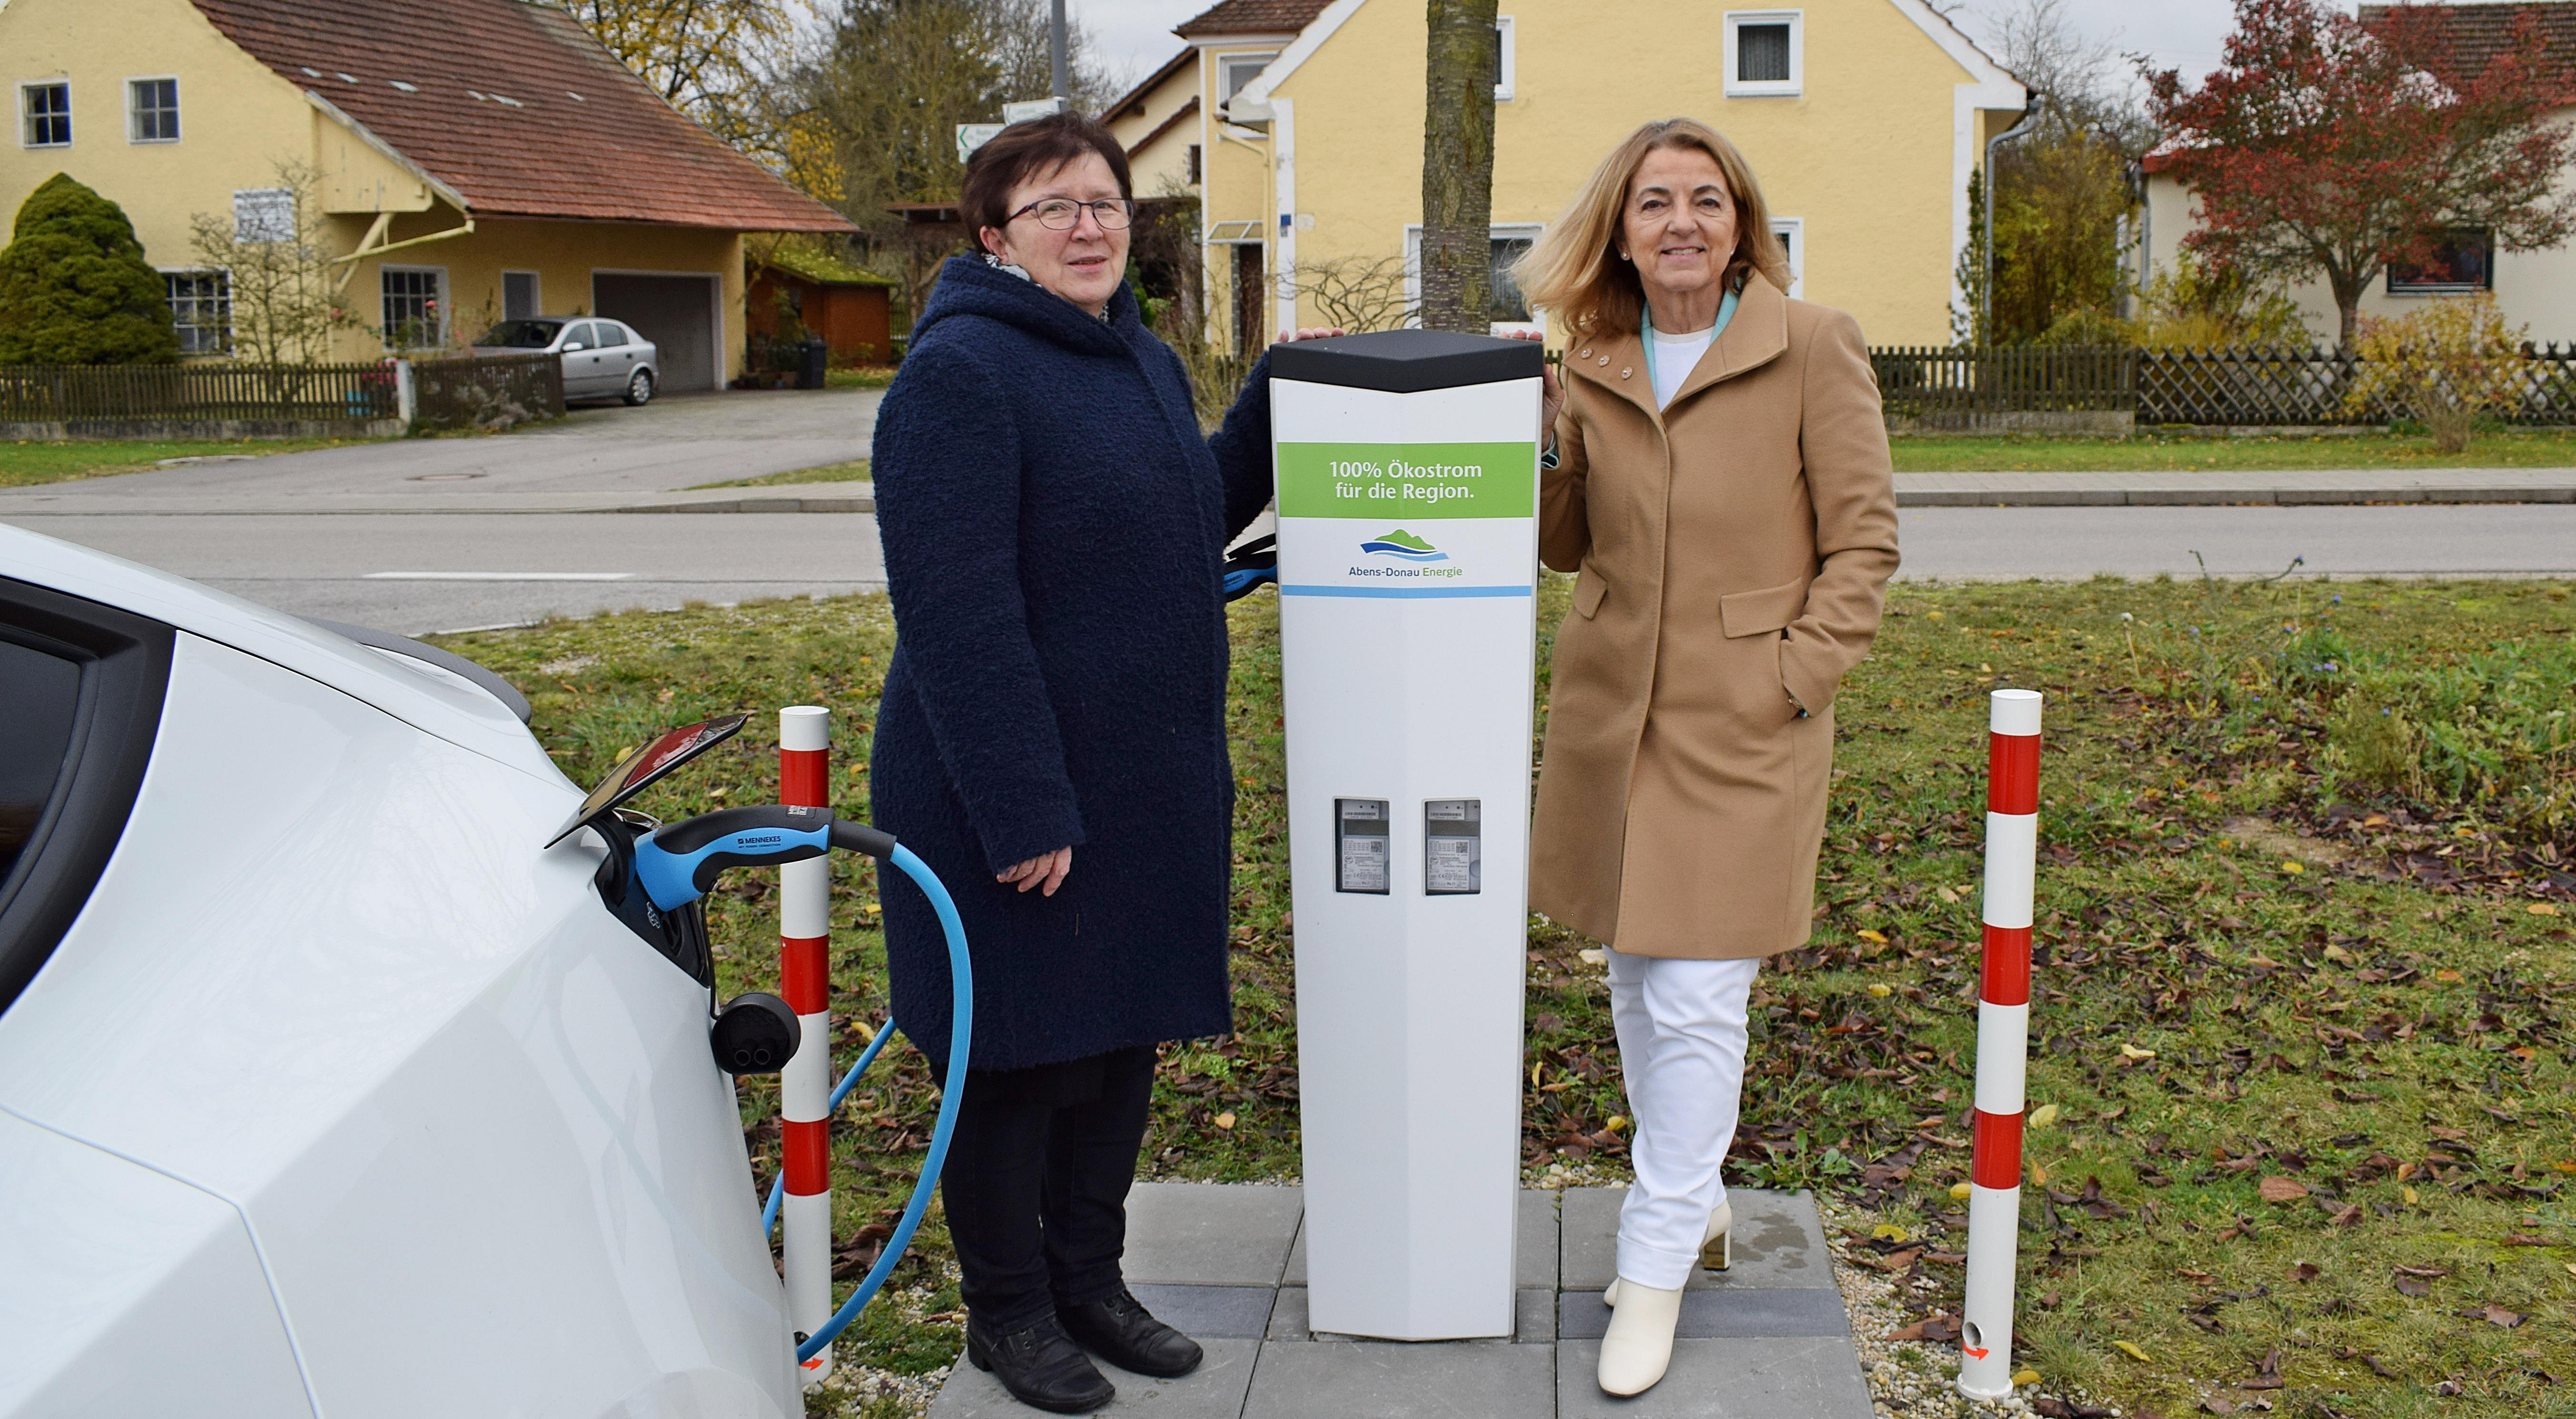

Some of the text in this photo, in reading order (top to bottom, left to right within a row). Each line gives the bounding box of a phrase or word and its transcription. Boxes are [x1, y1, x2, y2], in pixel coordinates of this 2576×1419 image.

[1330, 459, 1482, 478] 100% Ökostrom
[1335, 482, 1474, 504] für die Region.
[1349, 566, 1463, 577] Abens-Donau Energie
